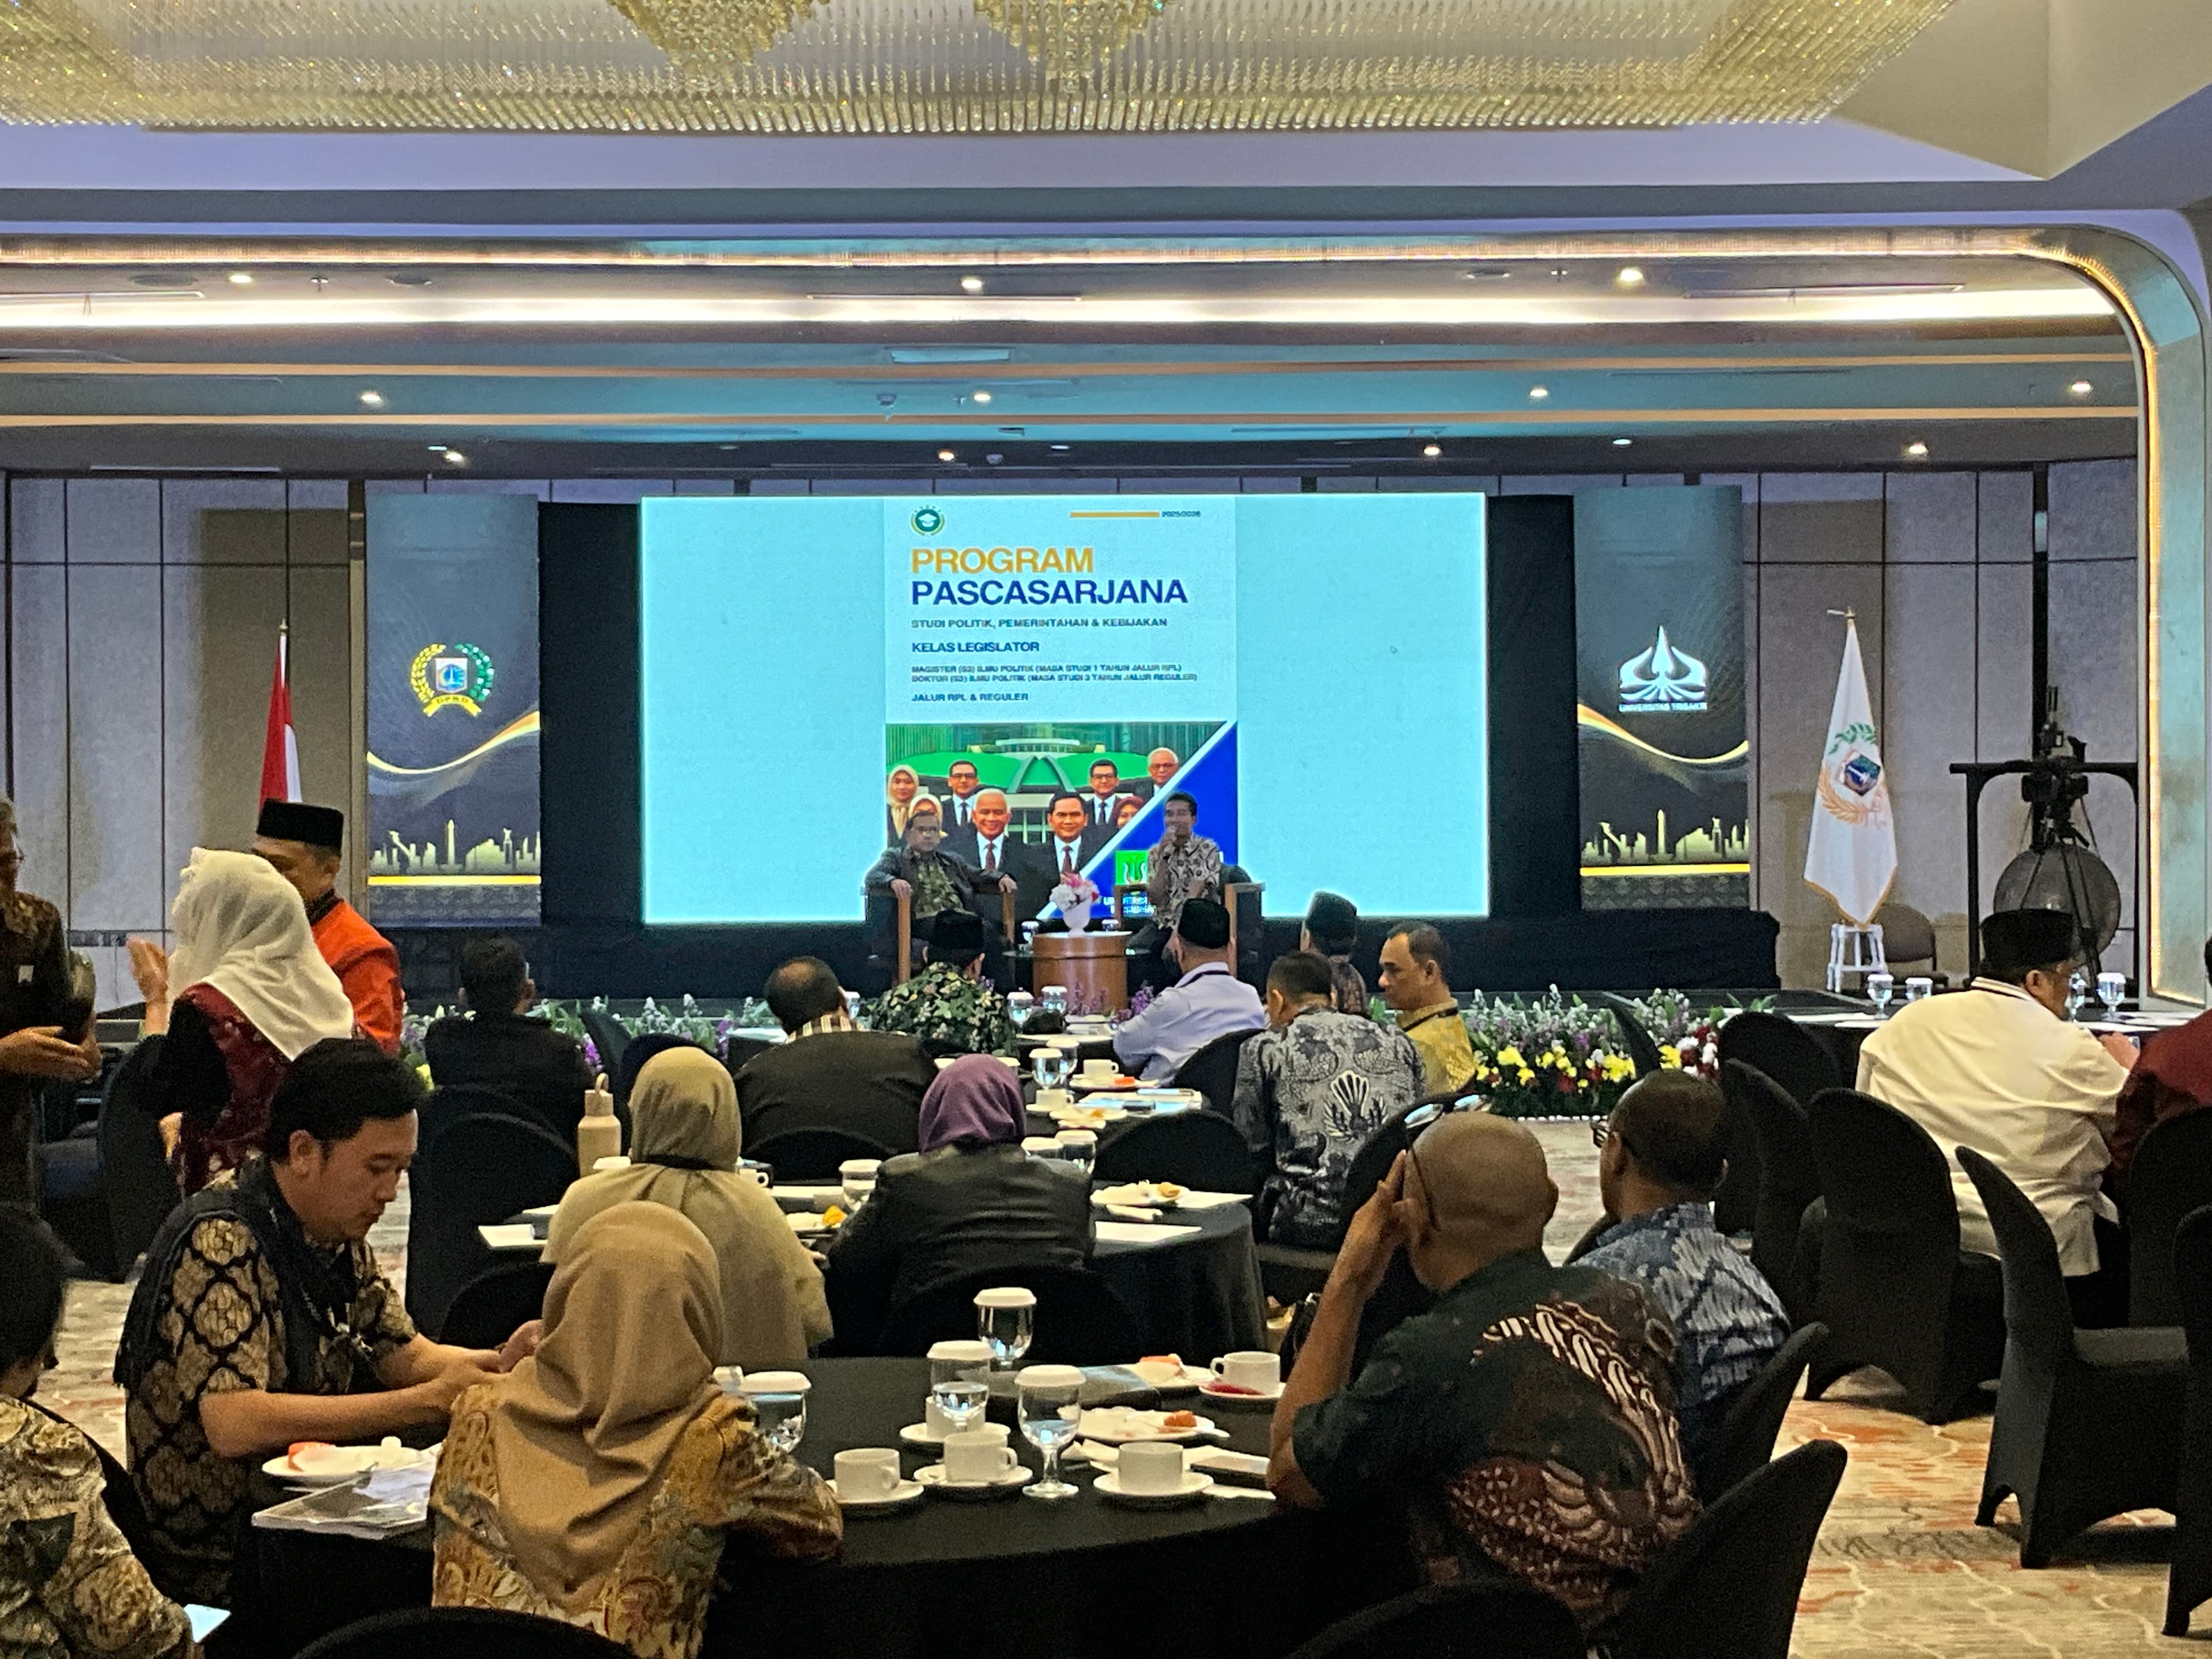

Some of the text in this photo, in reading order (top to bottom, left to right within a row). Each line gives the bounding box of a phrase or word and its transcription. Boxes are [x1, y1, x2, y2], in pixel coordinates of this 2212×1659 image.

[912, 547, 1093, 574] PROGRAM
[912, 579, 1188, 605] PASCASARJANA
[911, 618, 1168, 629] STUDI POLITIK, PEMERINTAHAN & KEBIJAKAN
[912, 642, 1040, 653] KELAS LEGISLATOR
[1035, 665, 1063, 673] (MASA
[1161, 664, 1182, 672] RPL)
[1028, 675, 1056, 683] (MASA
[1153, 673, 1198, 681] REGULER)
[911, 694, 945, 702] JALUR
[969, 693, 977, 701] &
[979, 693, 1029, 701] REGULER
